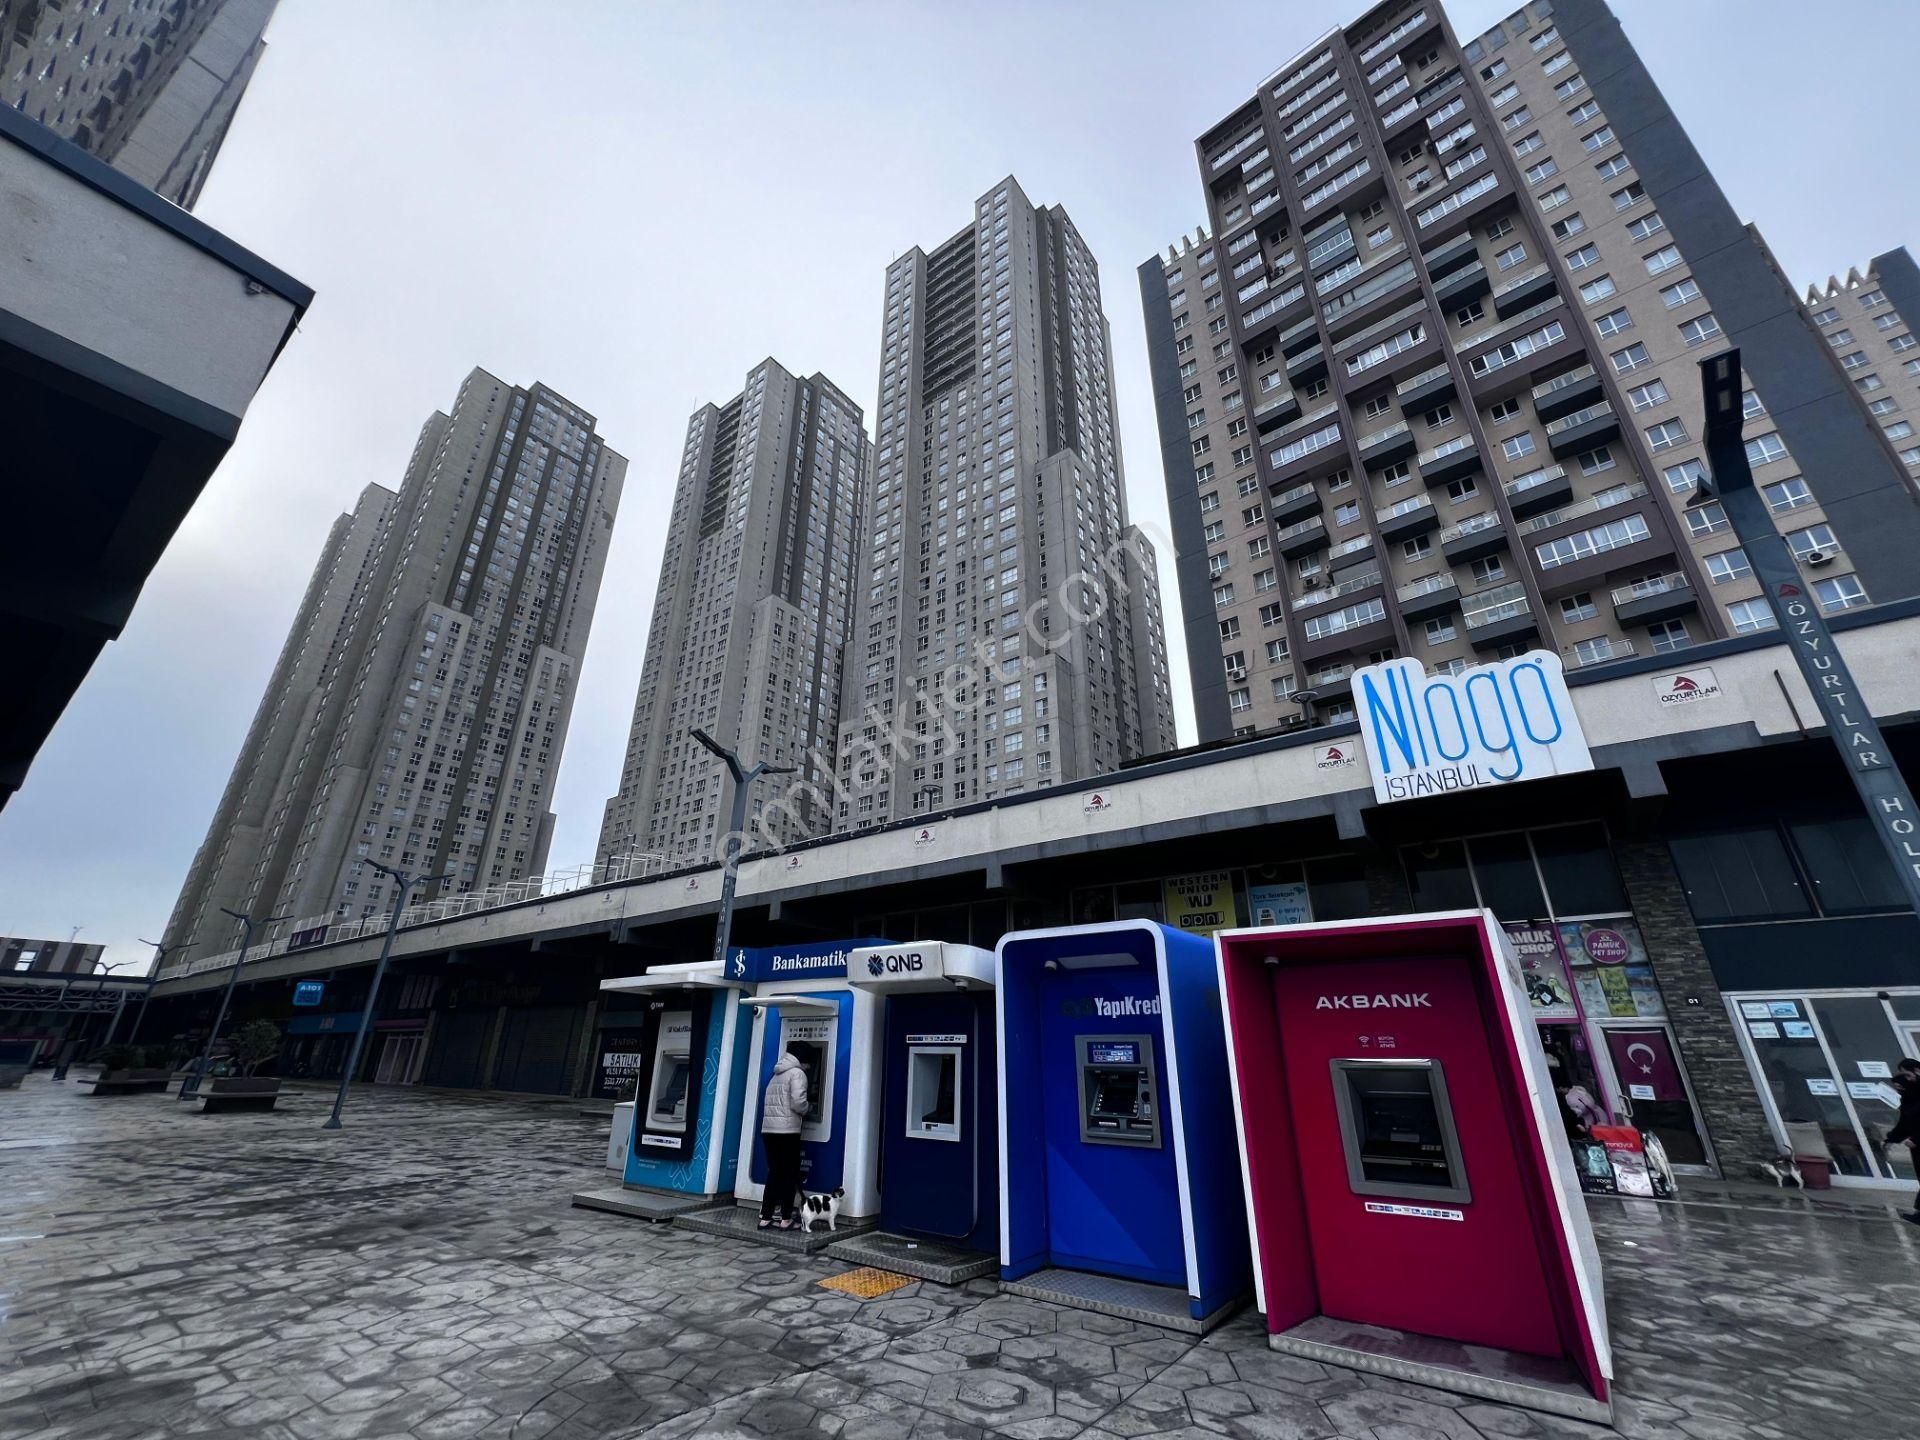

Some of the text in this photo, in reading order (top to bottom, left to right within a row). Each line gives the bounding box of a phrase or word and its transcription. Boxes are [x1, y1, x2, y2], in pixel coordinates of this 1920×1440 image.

[1788, 601, 1880, 767] ÖZYURTLAR
[1168, 872, 1229, 887] WESTERN
[1177, 883, 1219, 895] UNION
[1592, 941, 1620, 949] PAMUK
[772, 950, 847, 971] Bankamatik
[886, 954, 923, 973] QNB
[1315, 993, 1432, 1009] AKBANK
